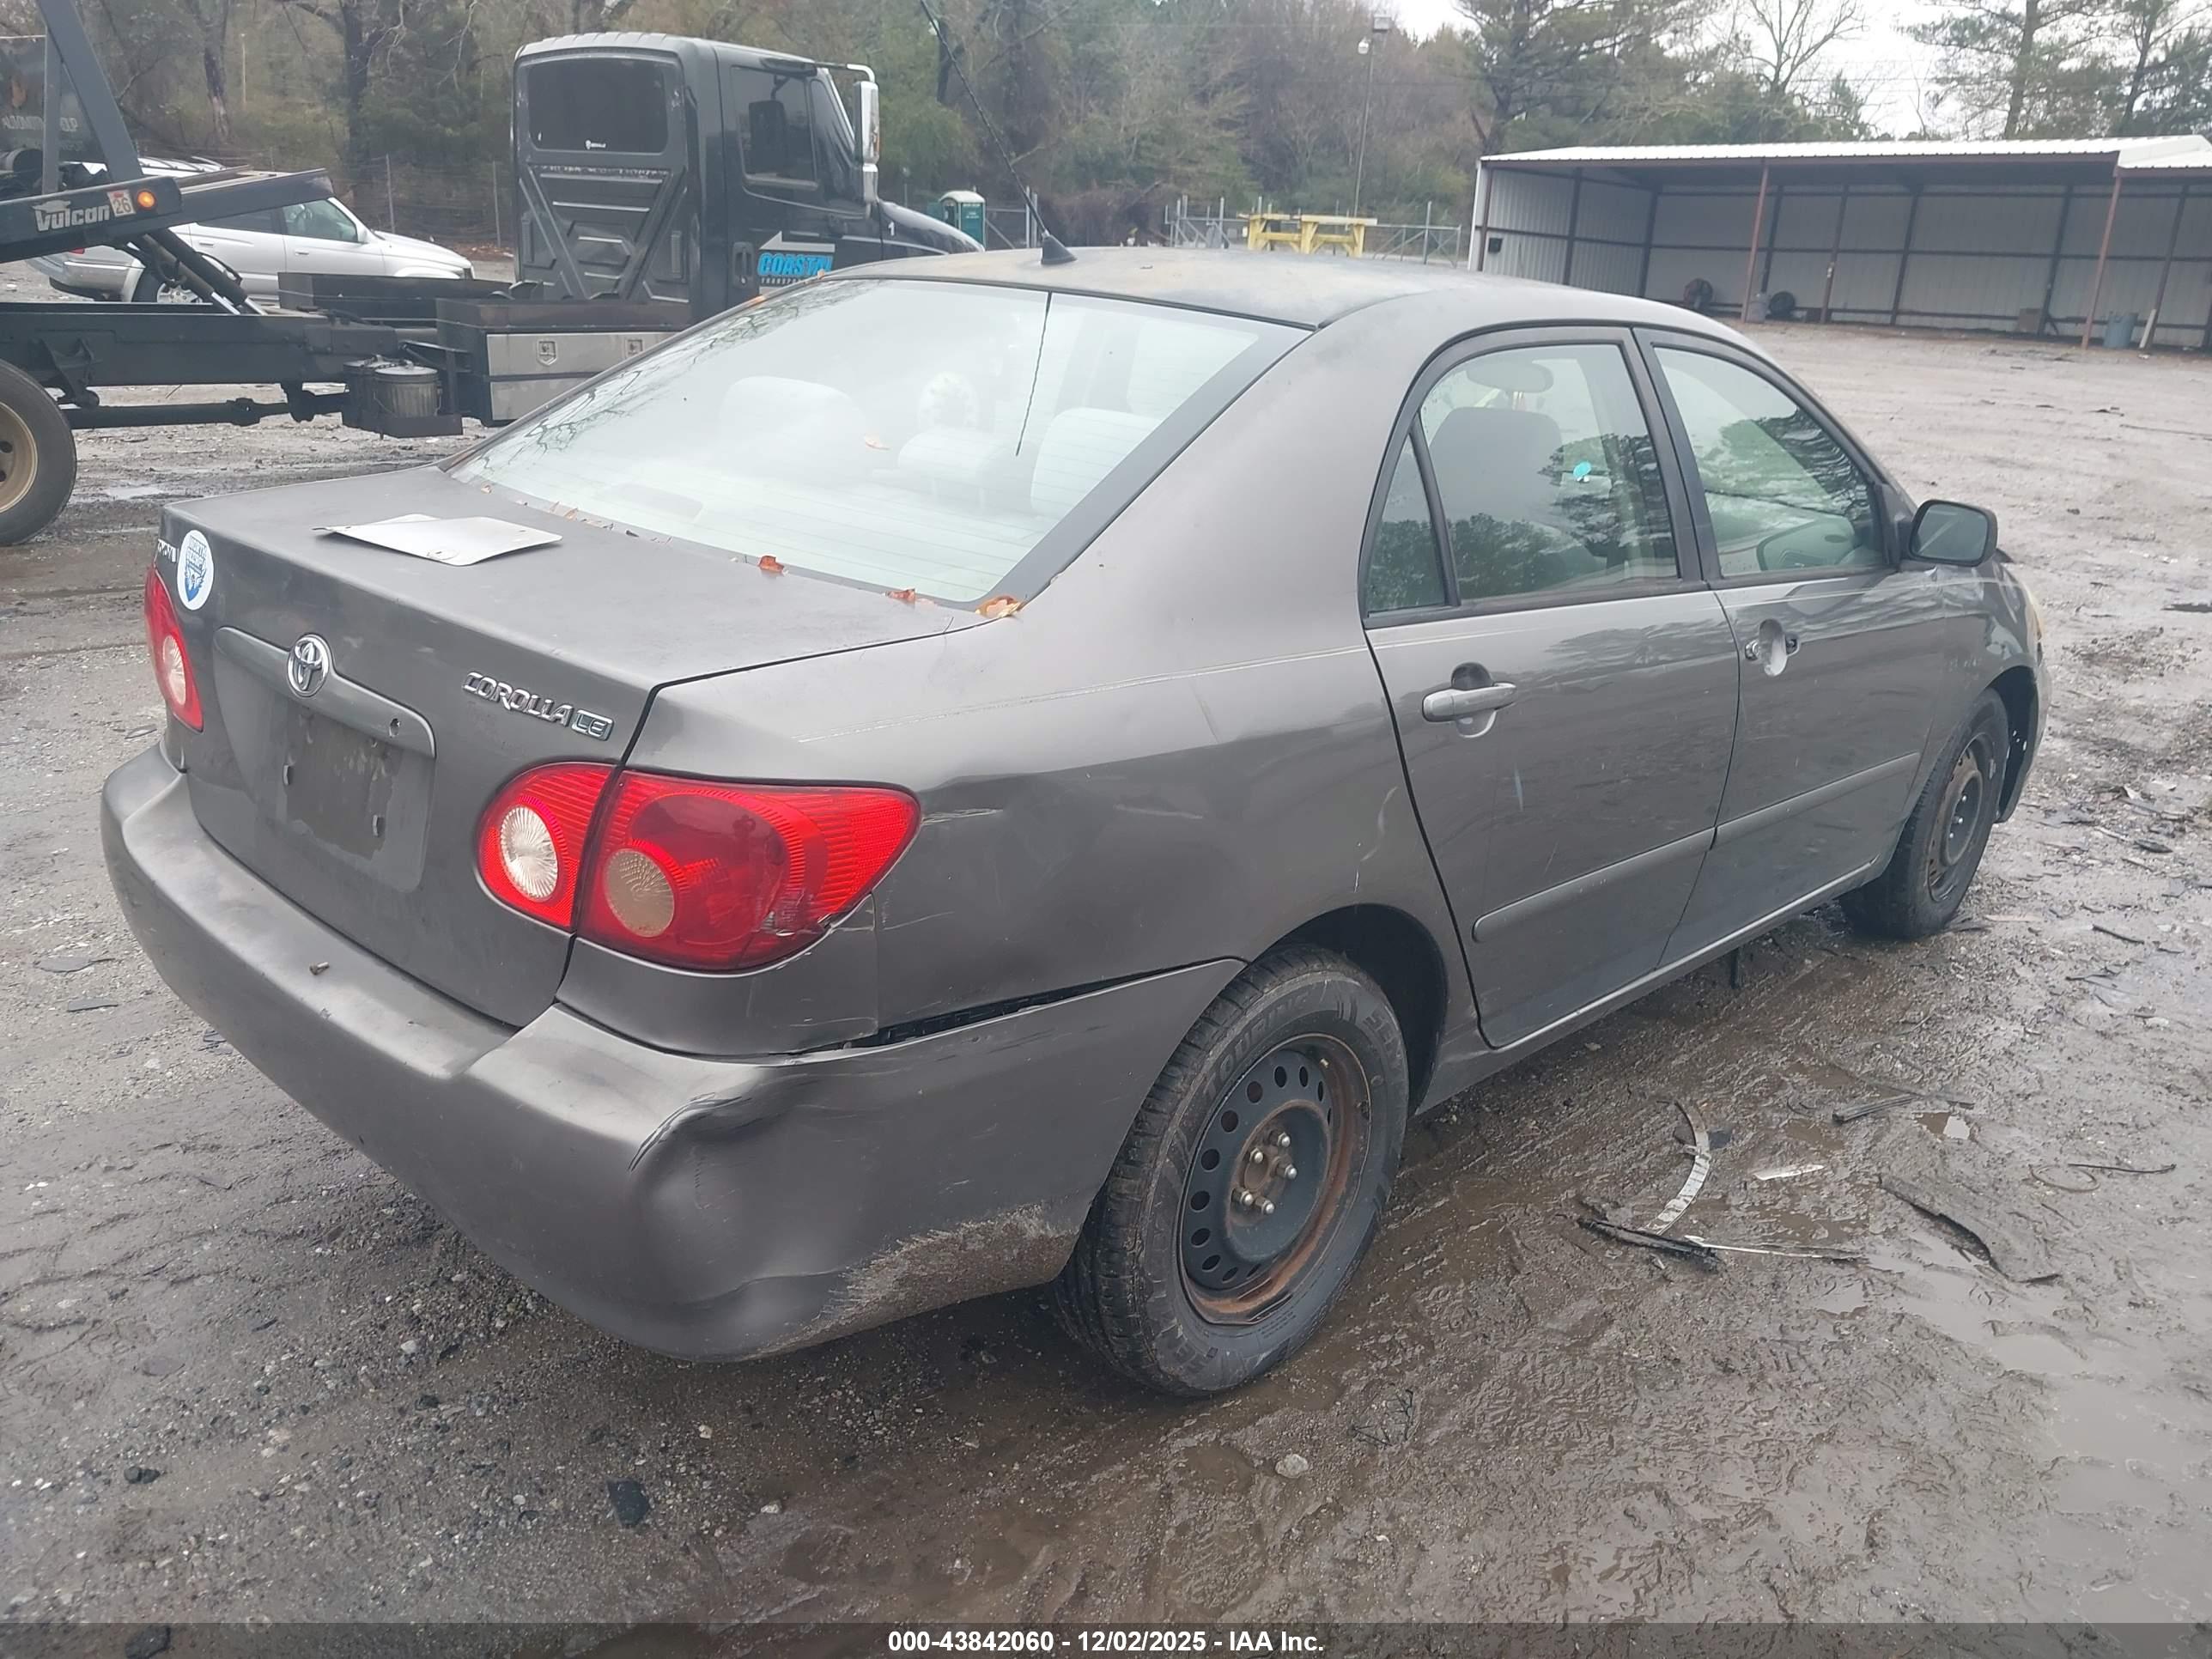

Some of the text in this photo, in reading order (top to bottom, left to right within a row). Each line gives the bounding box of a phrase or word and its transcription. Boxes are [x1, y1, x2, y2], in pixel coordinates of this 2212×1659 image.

[112, 198, 132, 215] 26
[35, 204, 110, 232] Vulcan
[888, 222, 895, 236] 1
[462, 672, 574, 727] COROLLA
